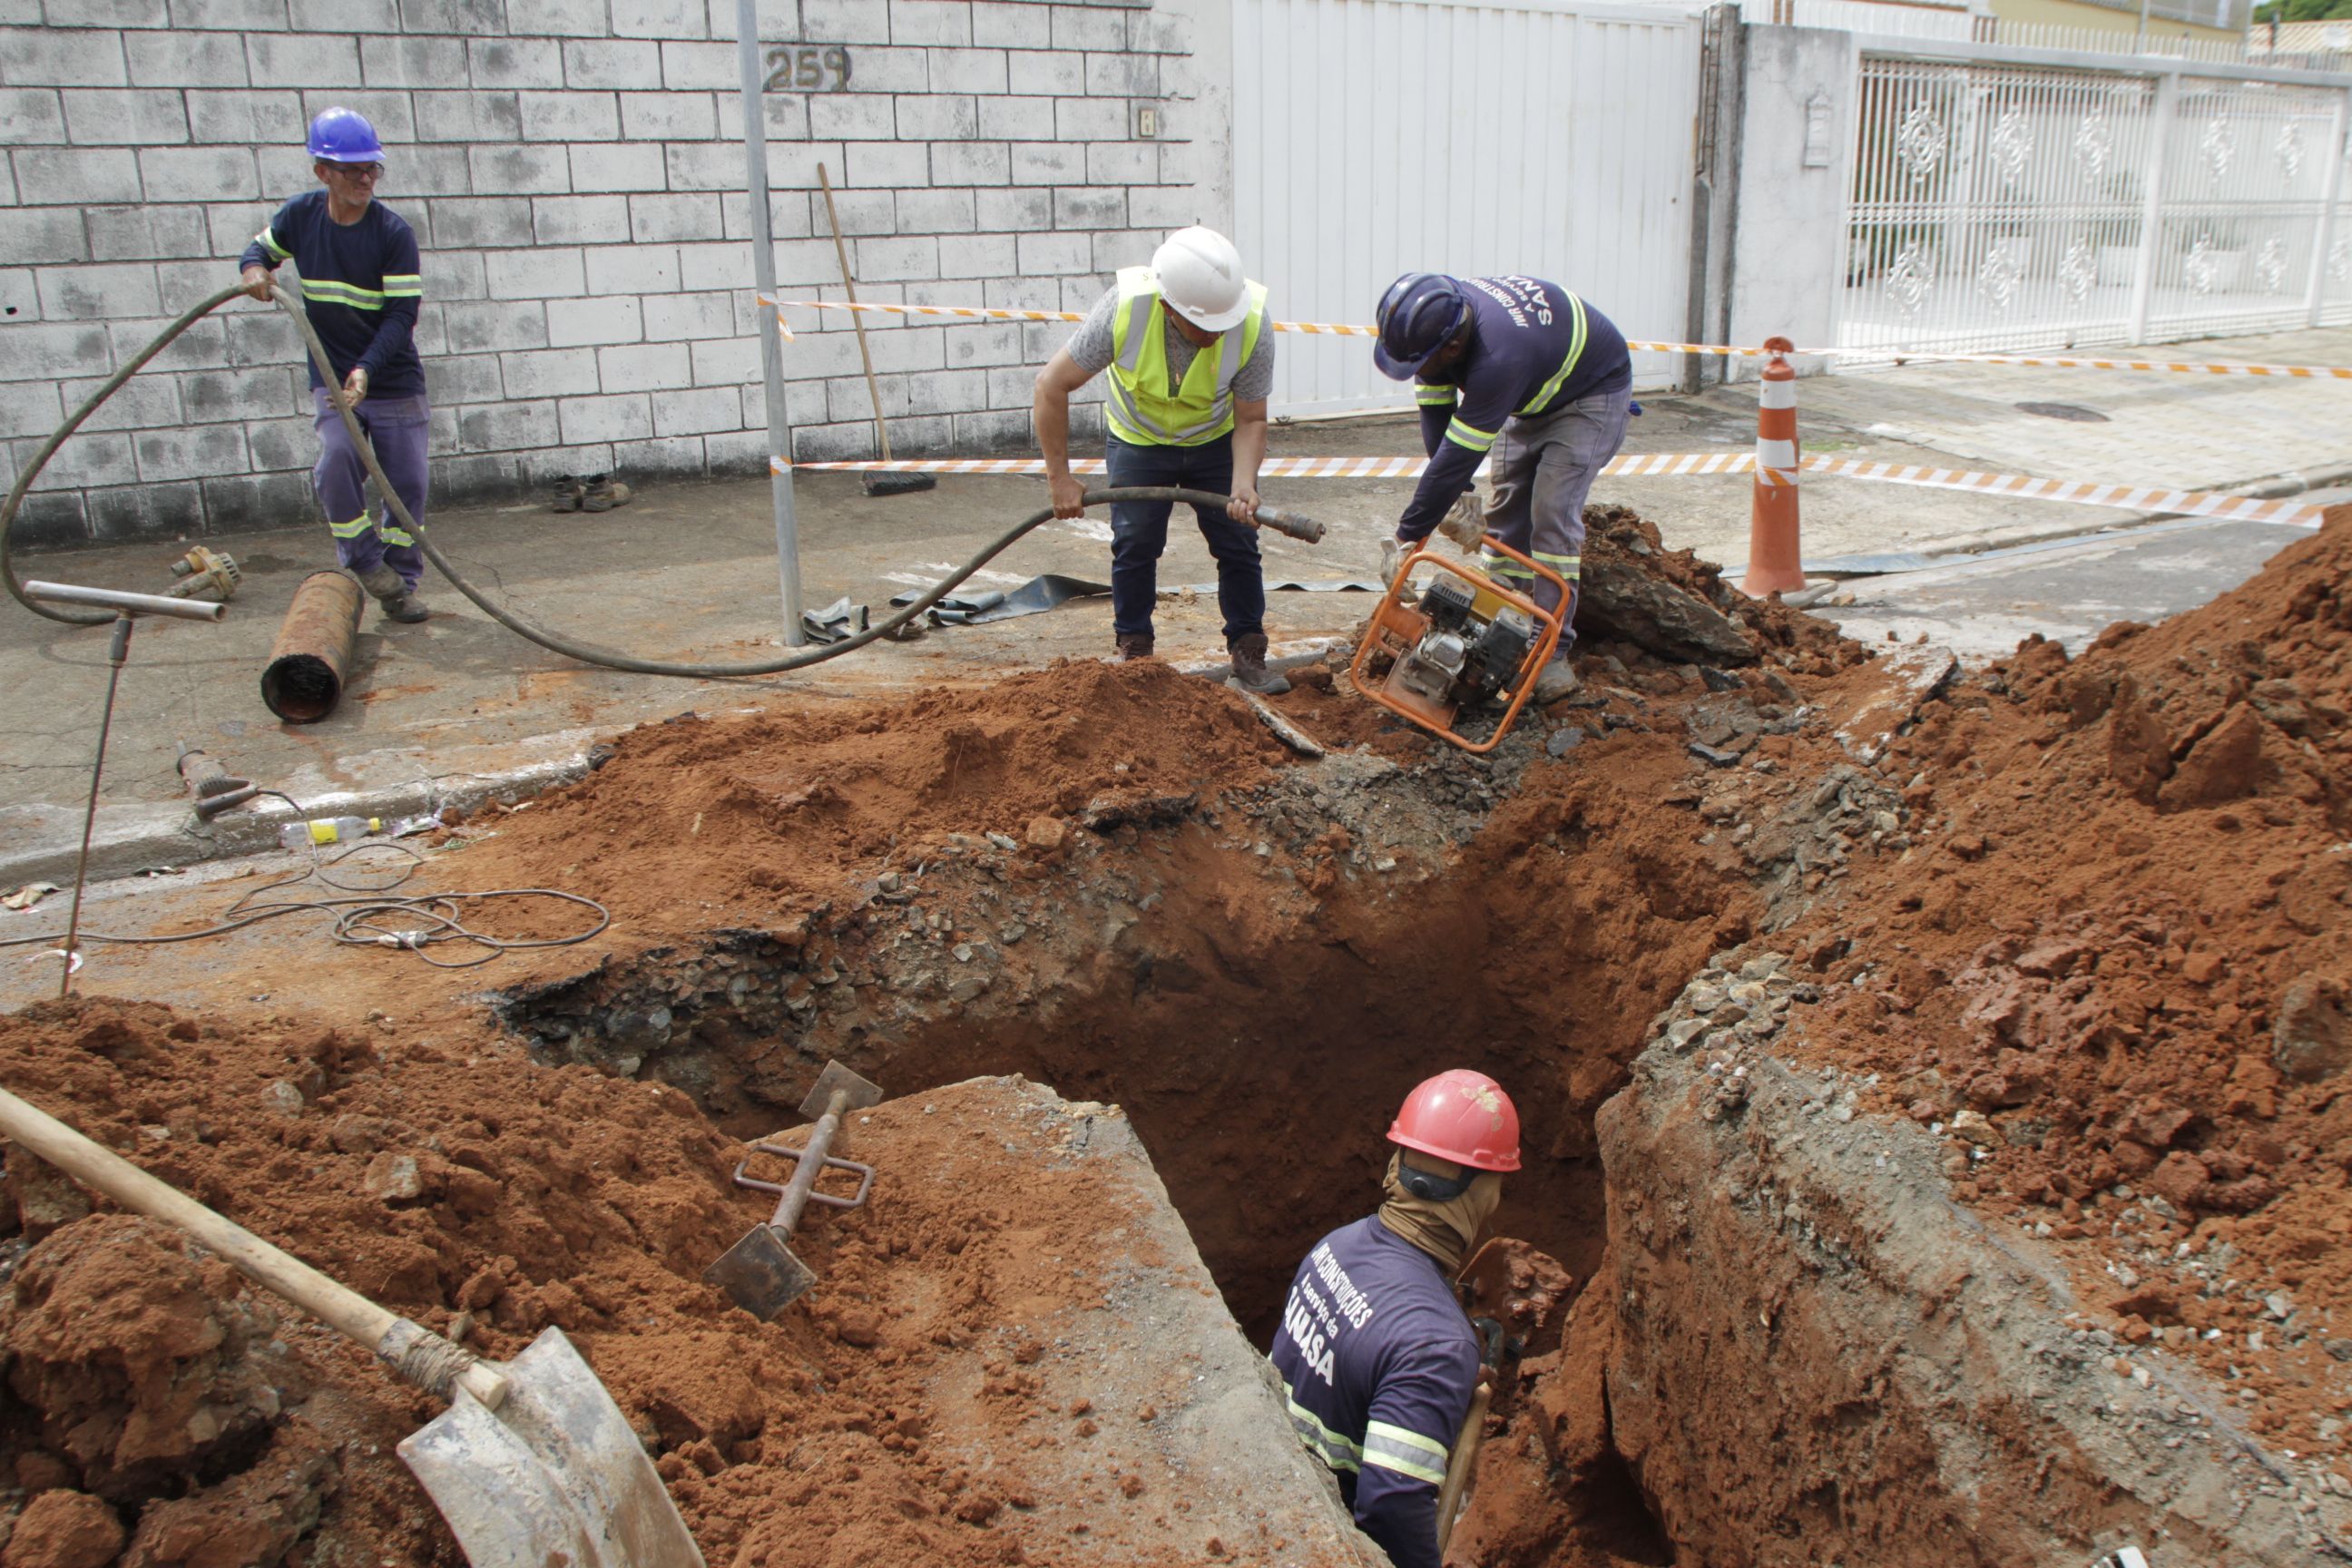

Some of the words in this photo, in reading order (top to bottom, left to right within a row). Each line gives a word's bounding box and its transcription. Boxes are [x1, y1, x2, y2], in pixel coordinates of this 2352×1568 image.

[764, 46, 849, 92] 259
[1524, 303, 1535, 312] A
[1303, 1282, 1329, 1323] serviço
[1326, 1318, 1338, 1339] da
